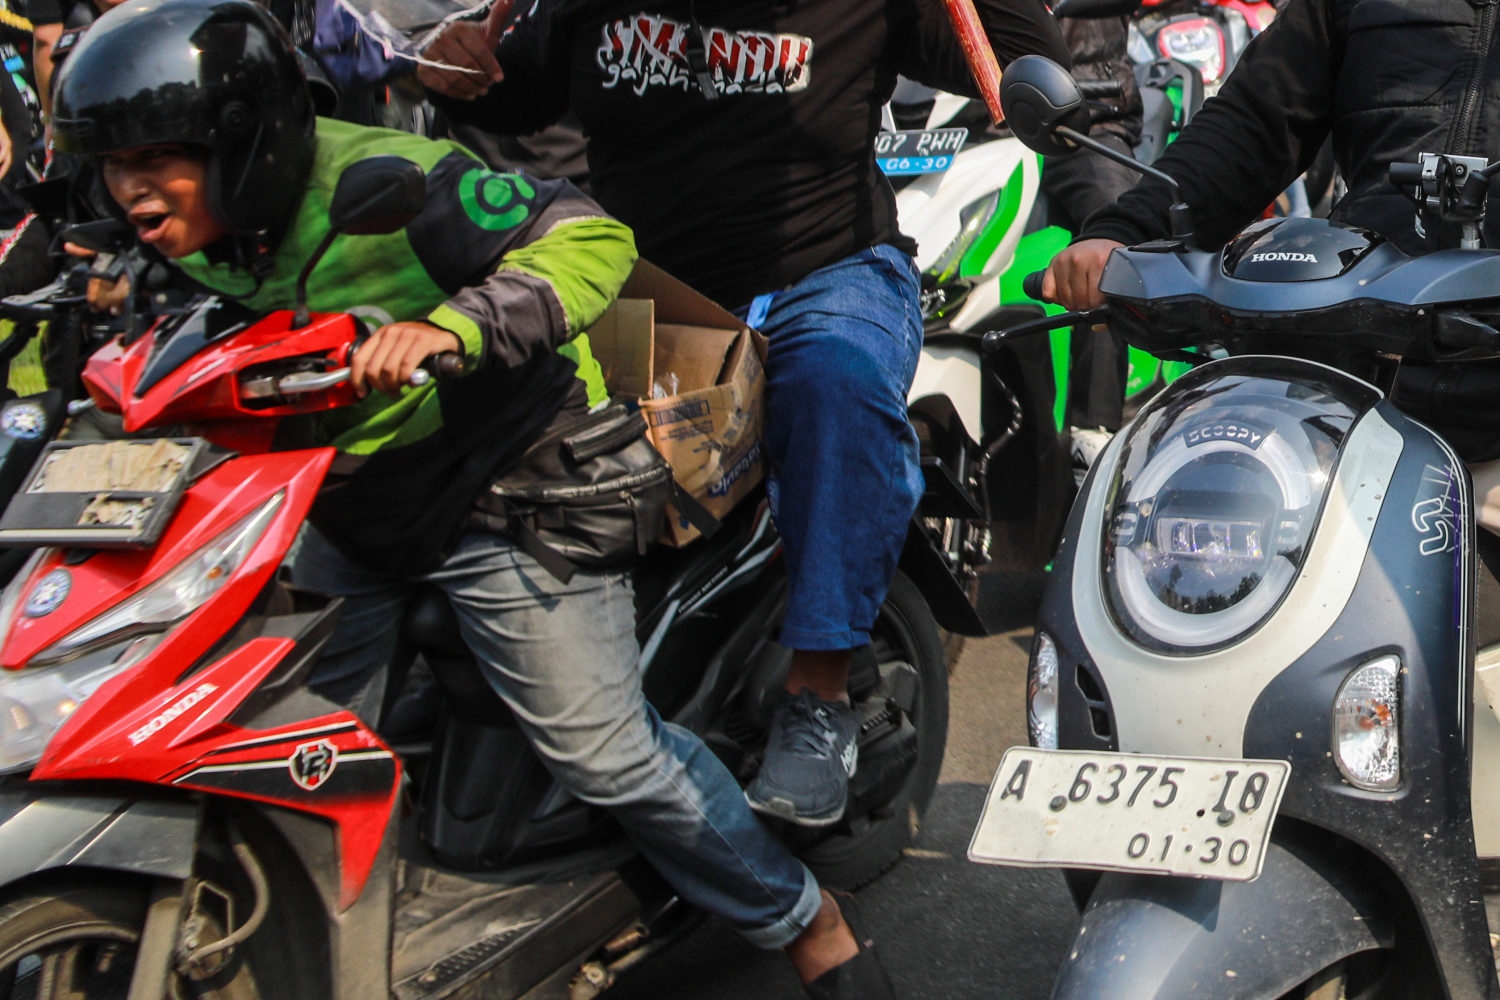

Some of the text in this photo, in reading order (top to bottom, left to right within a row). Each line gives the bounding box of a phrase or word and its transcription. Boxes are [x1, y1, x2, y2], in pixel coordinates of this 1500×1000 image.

[597, 12, 813, 92] SMNDU
[874, 133, 907, 154] 07
[1251, 252, 1318, 263] HONDA
[1188, 423, 1262, 443] SCOOPY
[127, 682, 219, 747] HONDA
[1001, 759, 1033, 801] A
[1068, 762, 1186, 808] 6375
